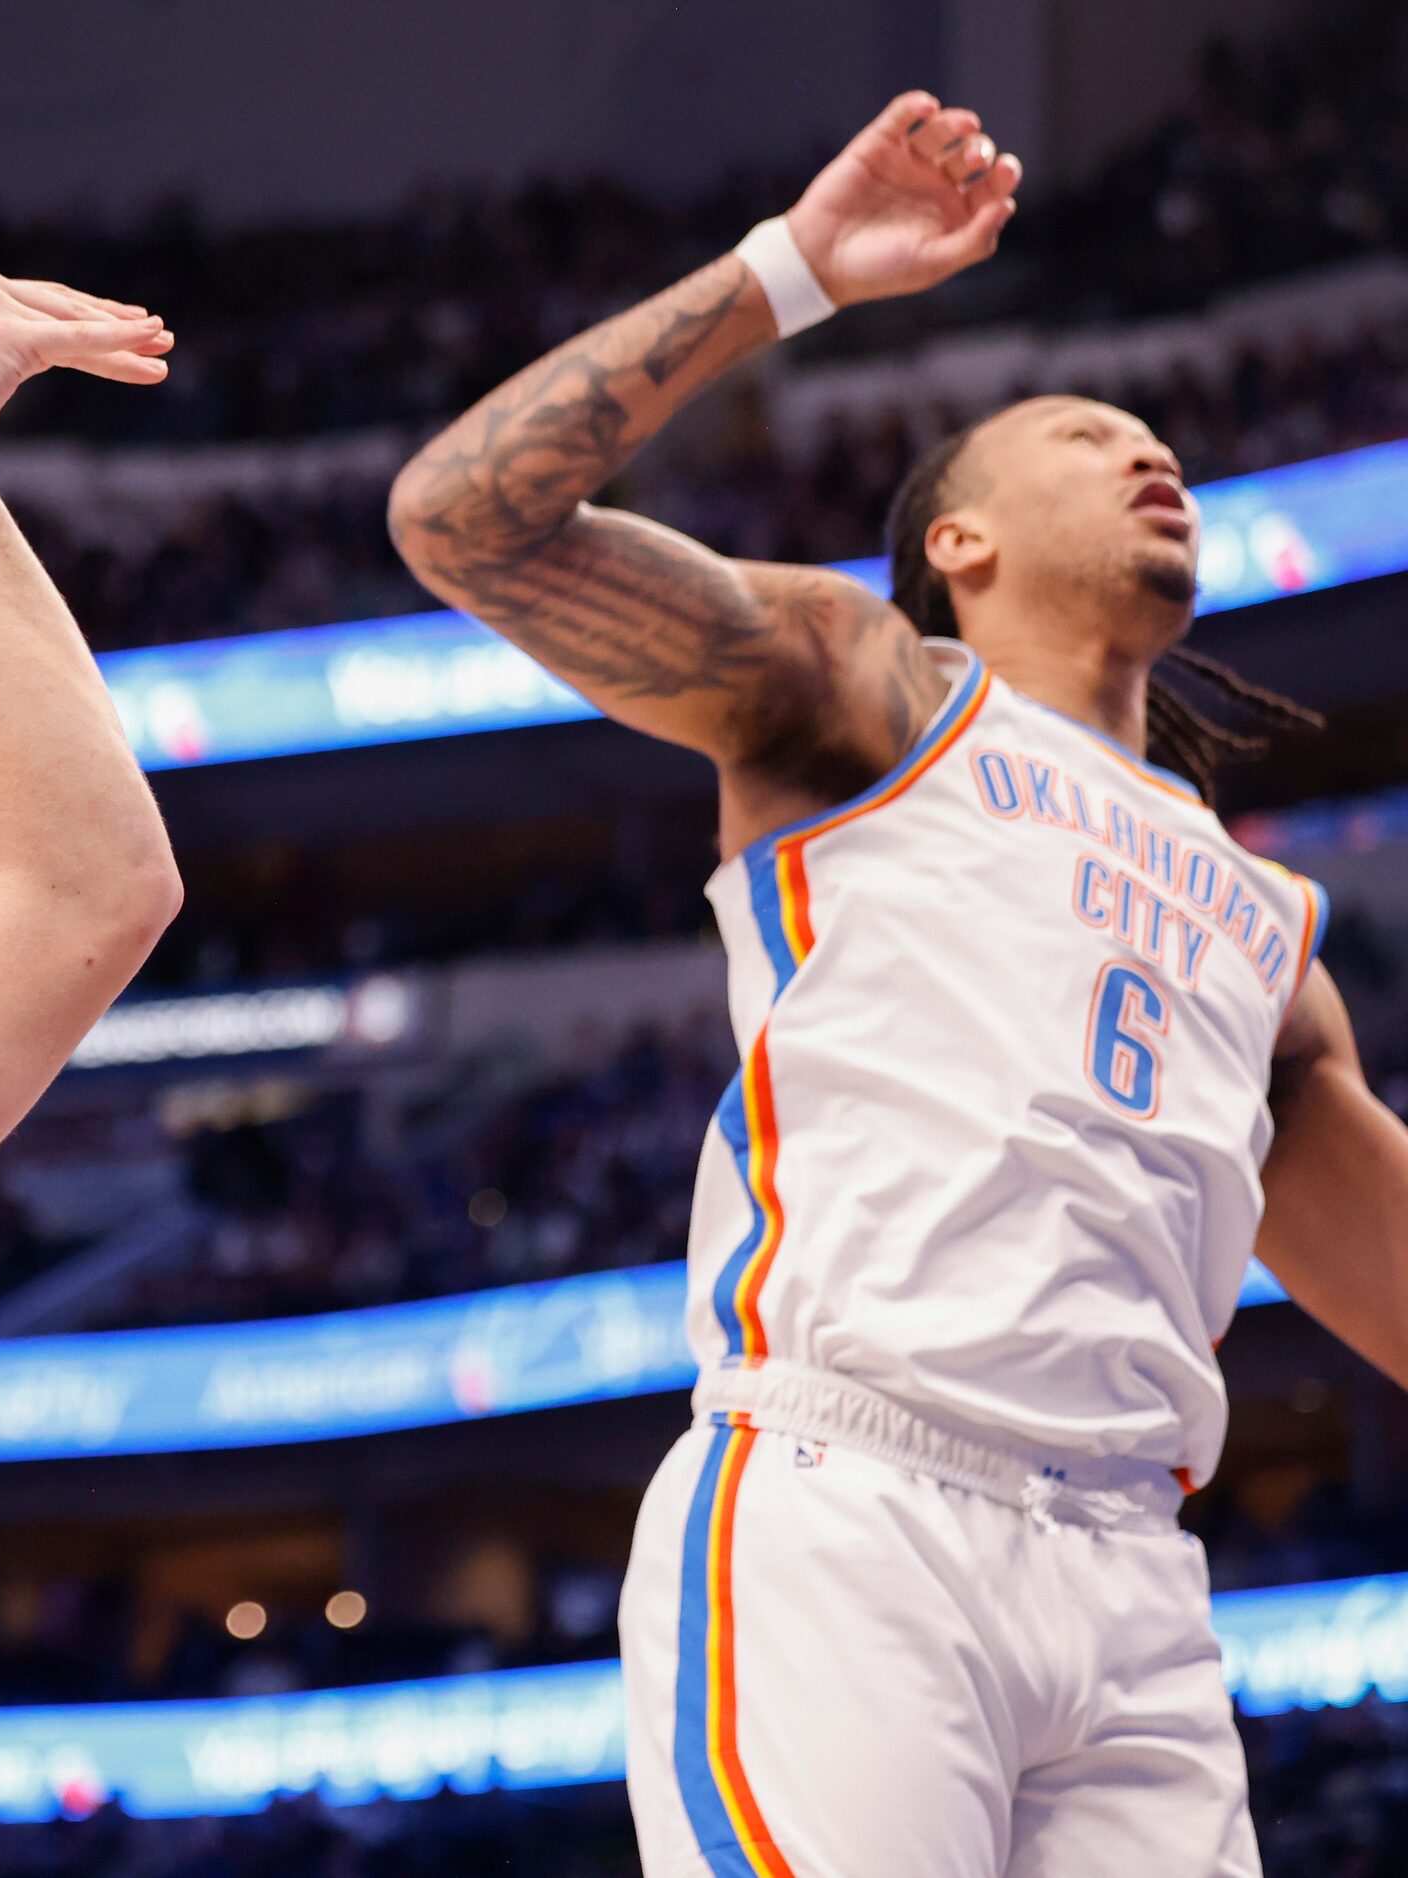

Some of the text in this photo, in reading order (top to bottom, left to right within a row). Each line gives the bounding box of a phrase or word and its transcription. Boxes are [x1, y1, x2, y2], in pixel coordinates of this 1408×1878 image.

[969, 747, 1289, 995] OKLAHOMA
[1072, 851, 1213, 992] CITY
[1083, 957, 1171, 1121] 6
